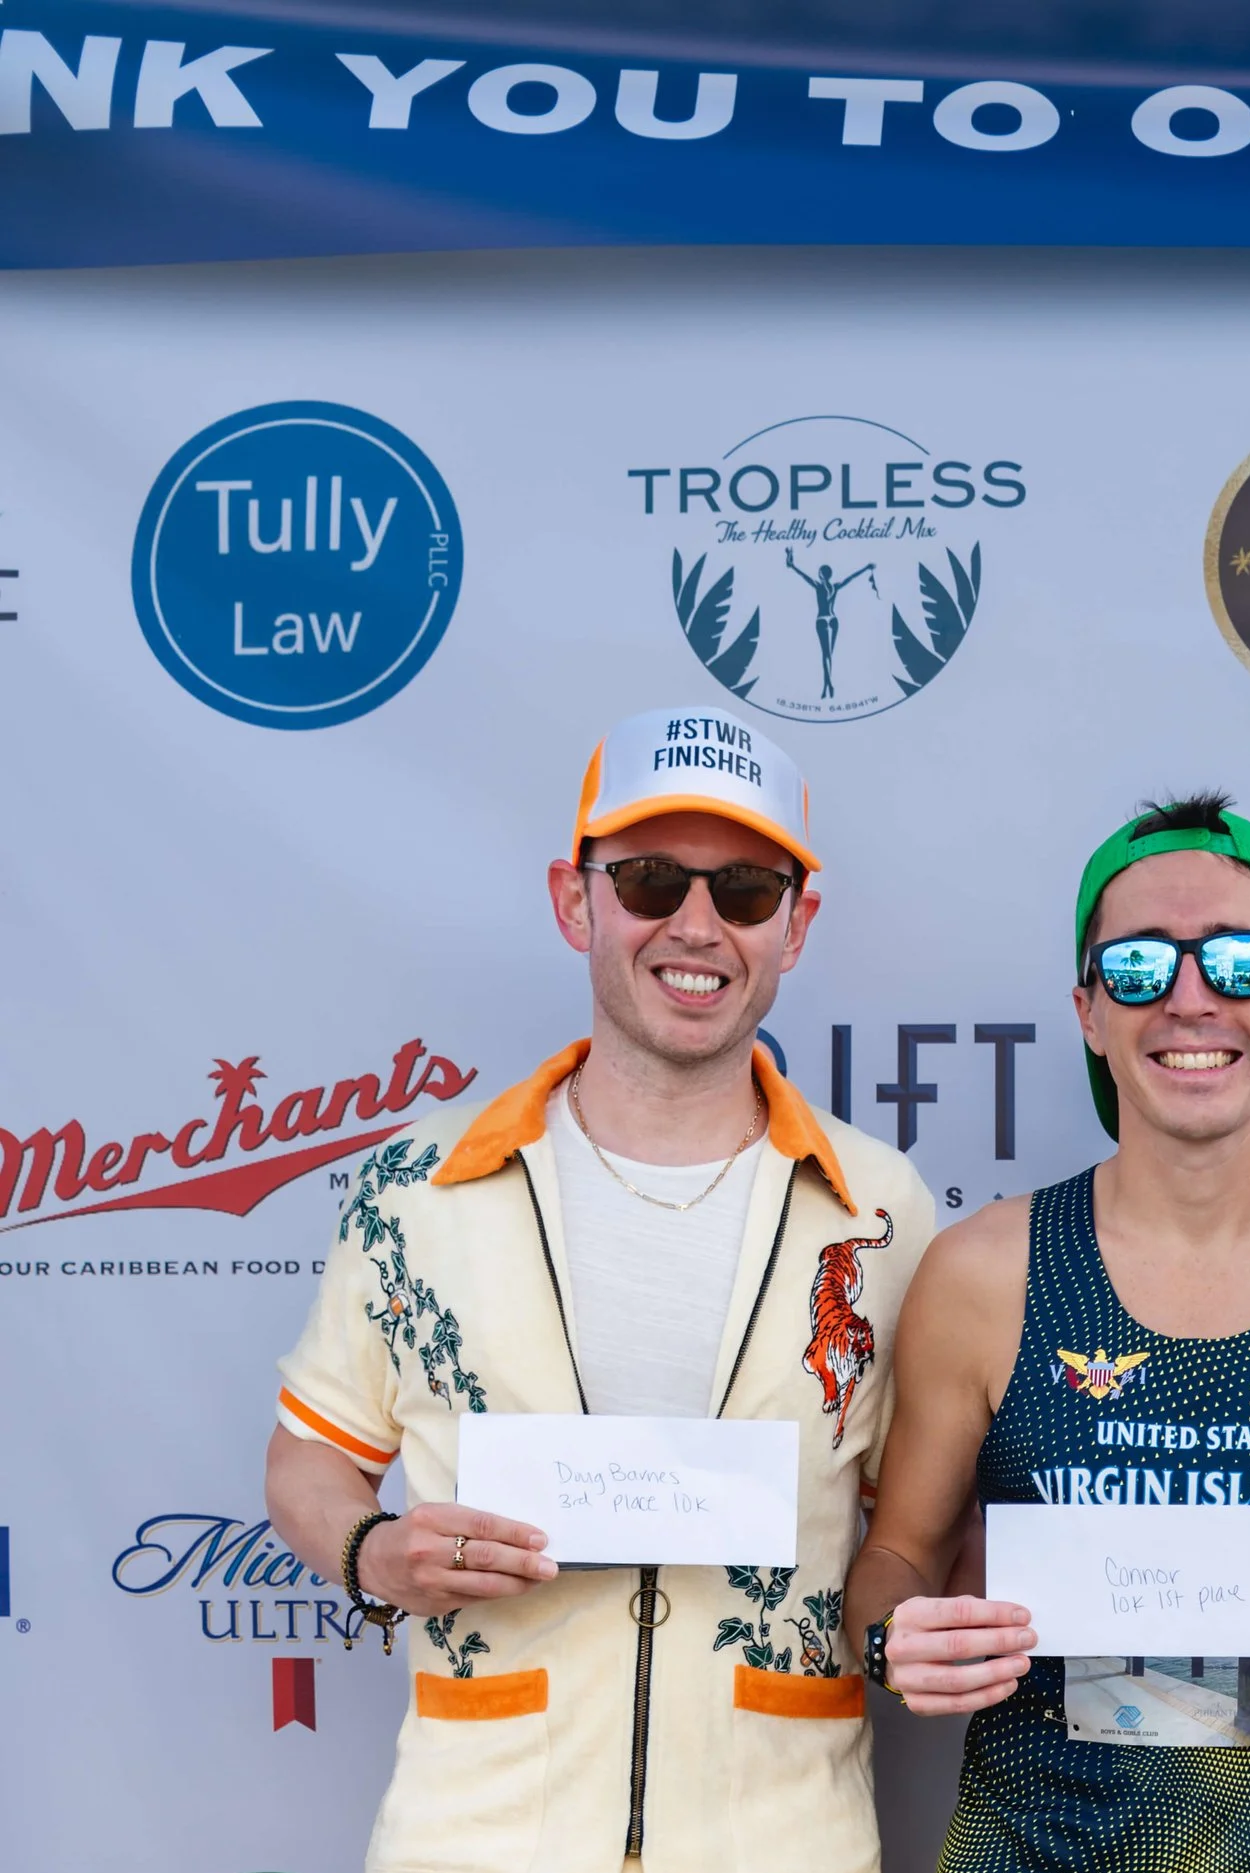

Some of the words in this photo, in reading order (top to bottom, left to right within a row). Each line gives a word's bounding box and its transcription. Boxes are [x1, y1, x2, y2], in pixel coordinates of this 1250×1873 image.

[335, 53, 738, 140] YOU
[808, 77, 1061, 152] TO
[627, 460, 1027, 514] TROPLESS
[196, 475, 399, 571] Tully
[715, 520, 746, 543] The
[751, 518, 817, 548] Healthy
[823, 516, 895, 542] Cocktail
[896, 516, 937, 540] Mix
[428, 533, 449, 588] PLLC
[233, 602, 362, 656] Law
[666, 718, 752, 753] #STWR
[653, 746, 763, 787] FINISHER
[0, 1038, 478, 1218] Merchants
[61, 1261, 218, 1275] CARIBBEAN
[231, 1260, 300, 1275] FOOD
[1097, 1420, 1198, 1450] UNITED
[1032, 1465, 1170, 1504] VIRGIN
[1105, 1556, 1181, 1587] Connor
